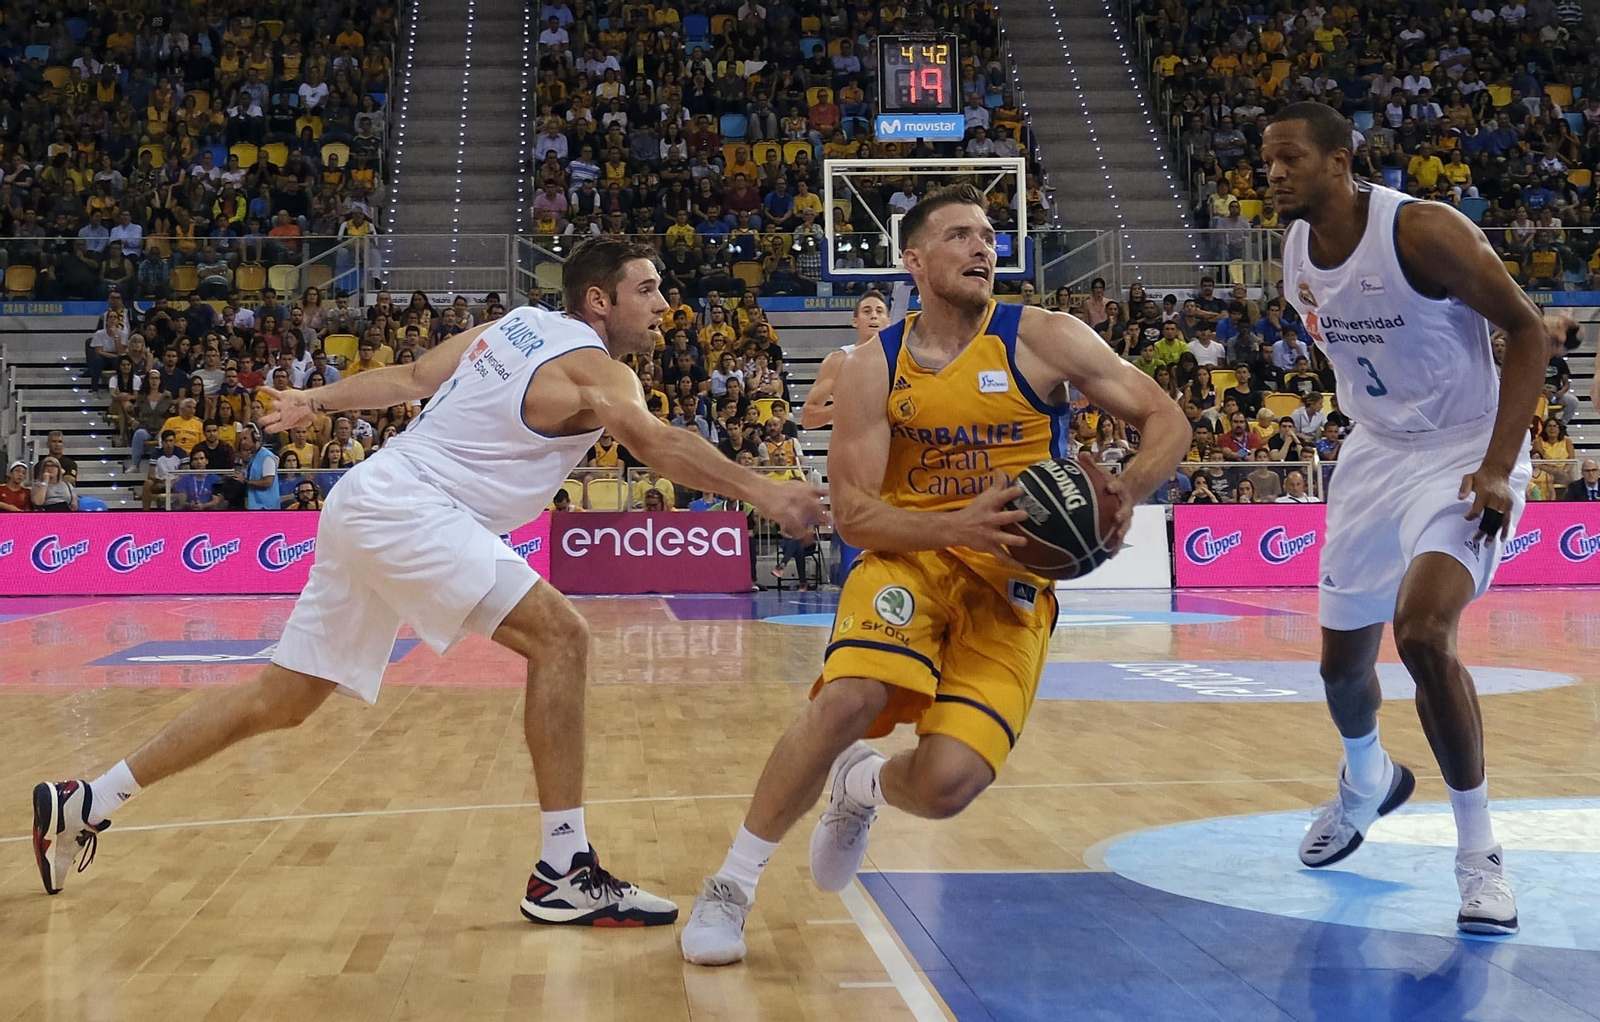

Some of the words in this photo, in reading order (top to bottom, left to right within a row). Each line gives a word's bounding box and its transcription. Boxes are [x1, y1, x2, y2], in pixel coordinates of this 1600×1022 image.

[901, 45, 914, 64] 4
[922, 44, 949, 65] 42
[909, 68, 943, 104] 19
[904, 122, 956, 132] movistar
[3, 303, 25, 314] GRAN
[28, 303, 63, 314] CANARIA
[804, 298, 826, 309] GRAN
[829, 298, 859, 309] CANAR
[1320, 315, 1405, 330] Universidad
[1325, 331, 1385, 345] Europea
[1357, 356, 1387, 397] 3
[921, 447, 990, 471] Gran
[30, 534, 90, 574] Clipper
[106, 533, 165, 574] Clipper
[181, 533, 241, 573] Clipper
[257, 532, 317, 572] Clipper
[562, 518, 742, 557] endesa
[1184, 526, 1242, 566] Clipper
[1258, 525, 1316, 565] Clipper
[1500, 528, 1541, 563] lipper
[1558, 523, 1600, 562] Clip
